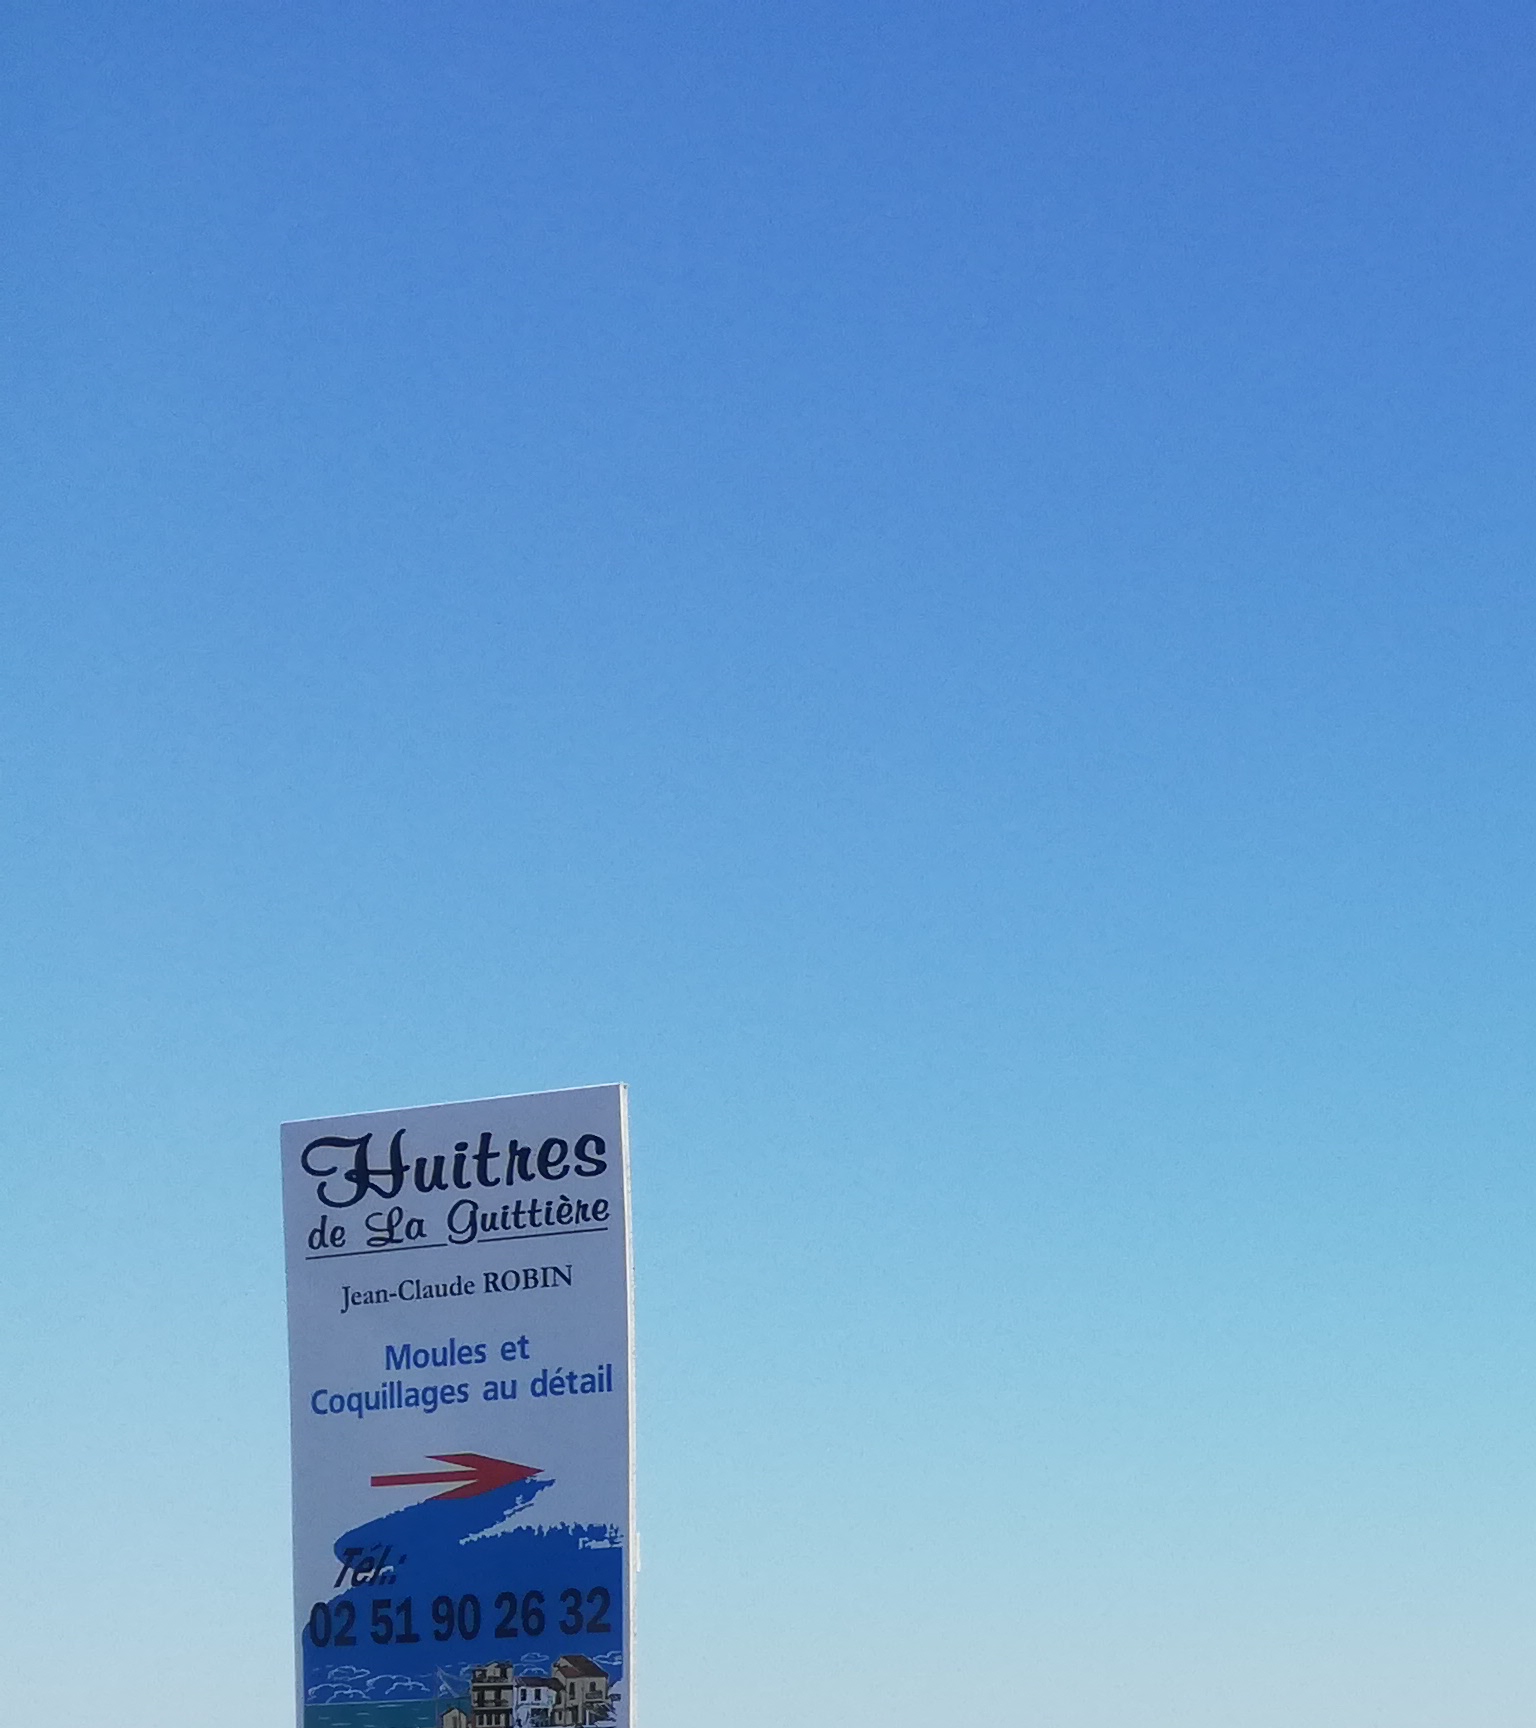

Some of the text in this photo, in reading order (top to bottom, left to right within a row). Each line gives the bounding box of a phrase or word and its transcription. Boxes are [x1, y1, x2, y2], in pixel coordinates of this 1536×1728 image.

[300, 1128, 608, 1208] Huitres
[308, 1195, 610, 1250] de La Guittière
[340, 1265, 573, 1314] Jean-Claude ROBIN
[385, 1335, 531, 1371] Moules et
[311, 1364, 613, 1419] Coquillages au détail
[309, 1587, 611, 1648] 02 51 90 26 32
